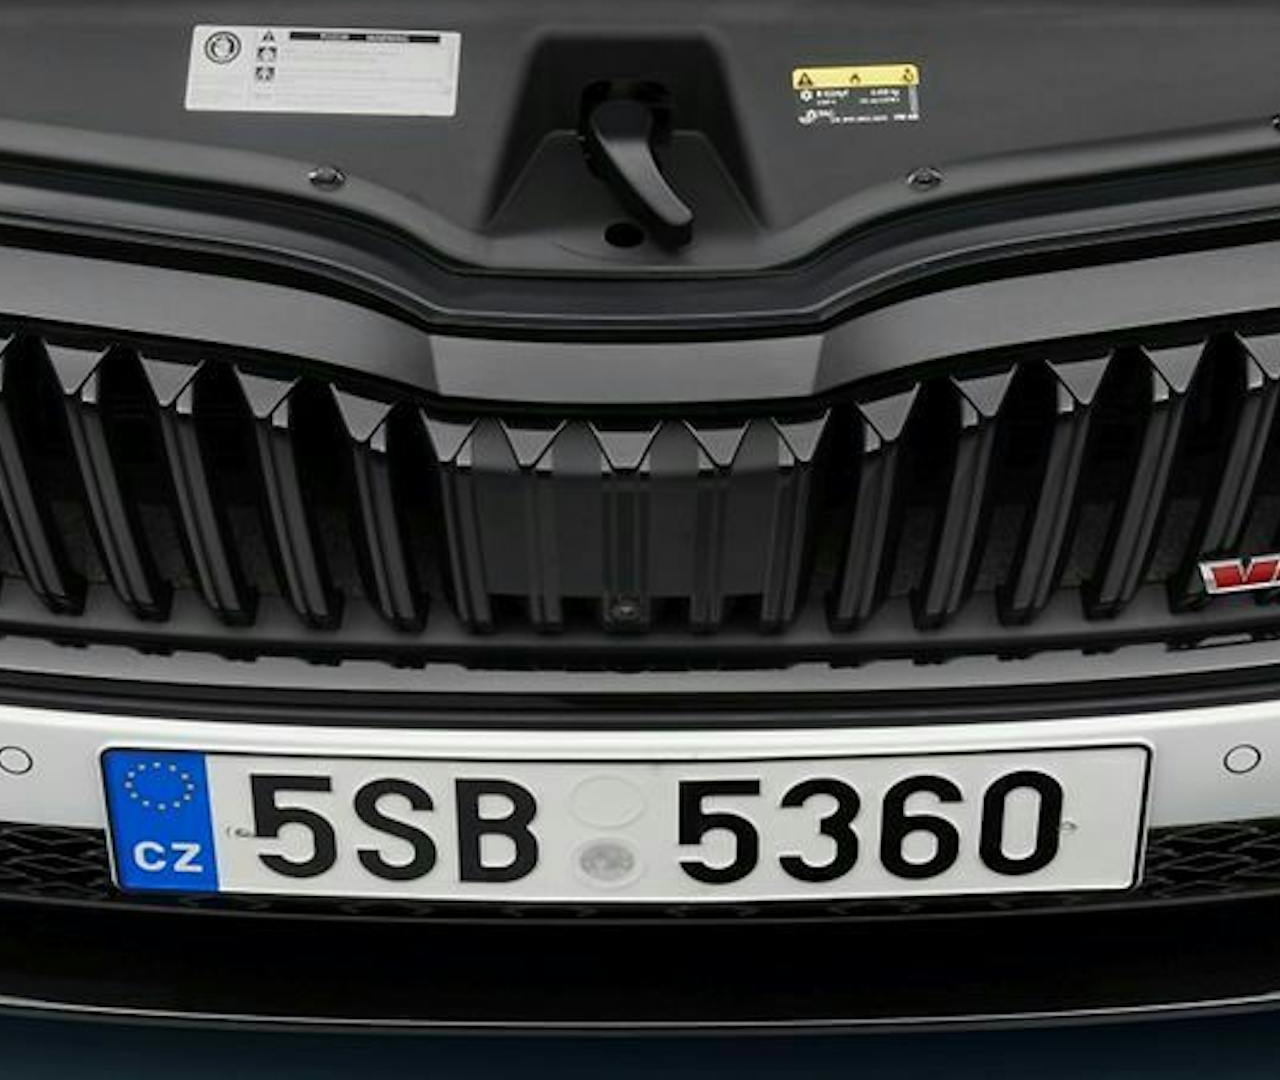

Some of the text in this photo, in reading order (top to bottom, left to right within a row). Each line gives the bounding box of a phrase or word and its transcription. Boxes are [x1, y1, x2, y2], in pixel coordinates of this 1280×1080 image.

[133, 839, 204, 873] CZ
[249, 770, 1064, 886] 5SB 5360
